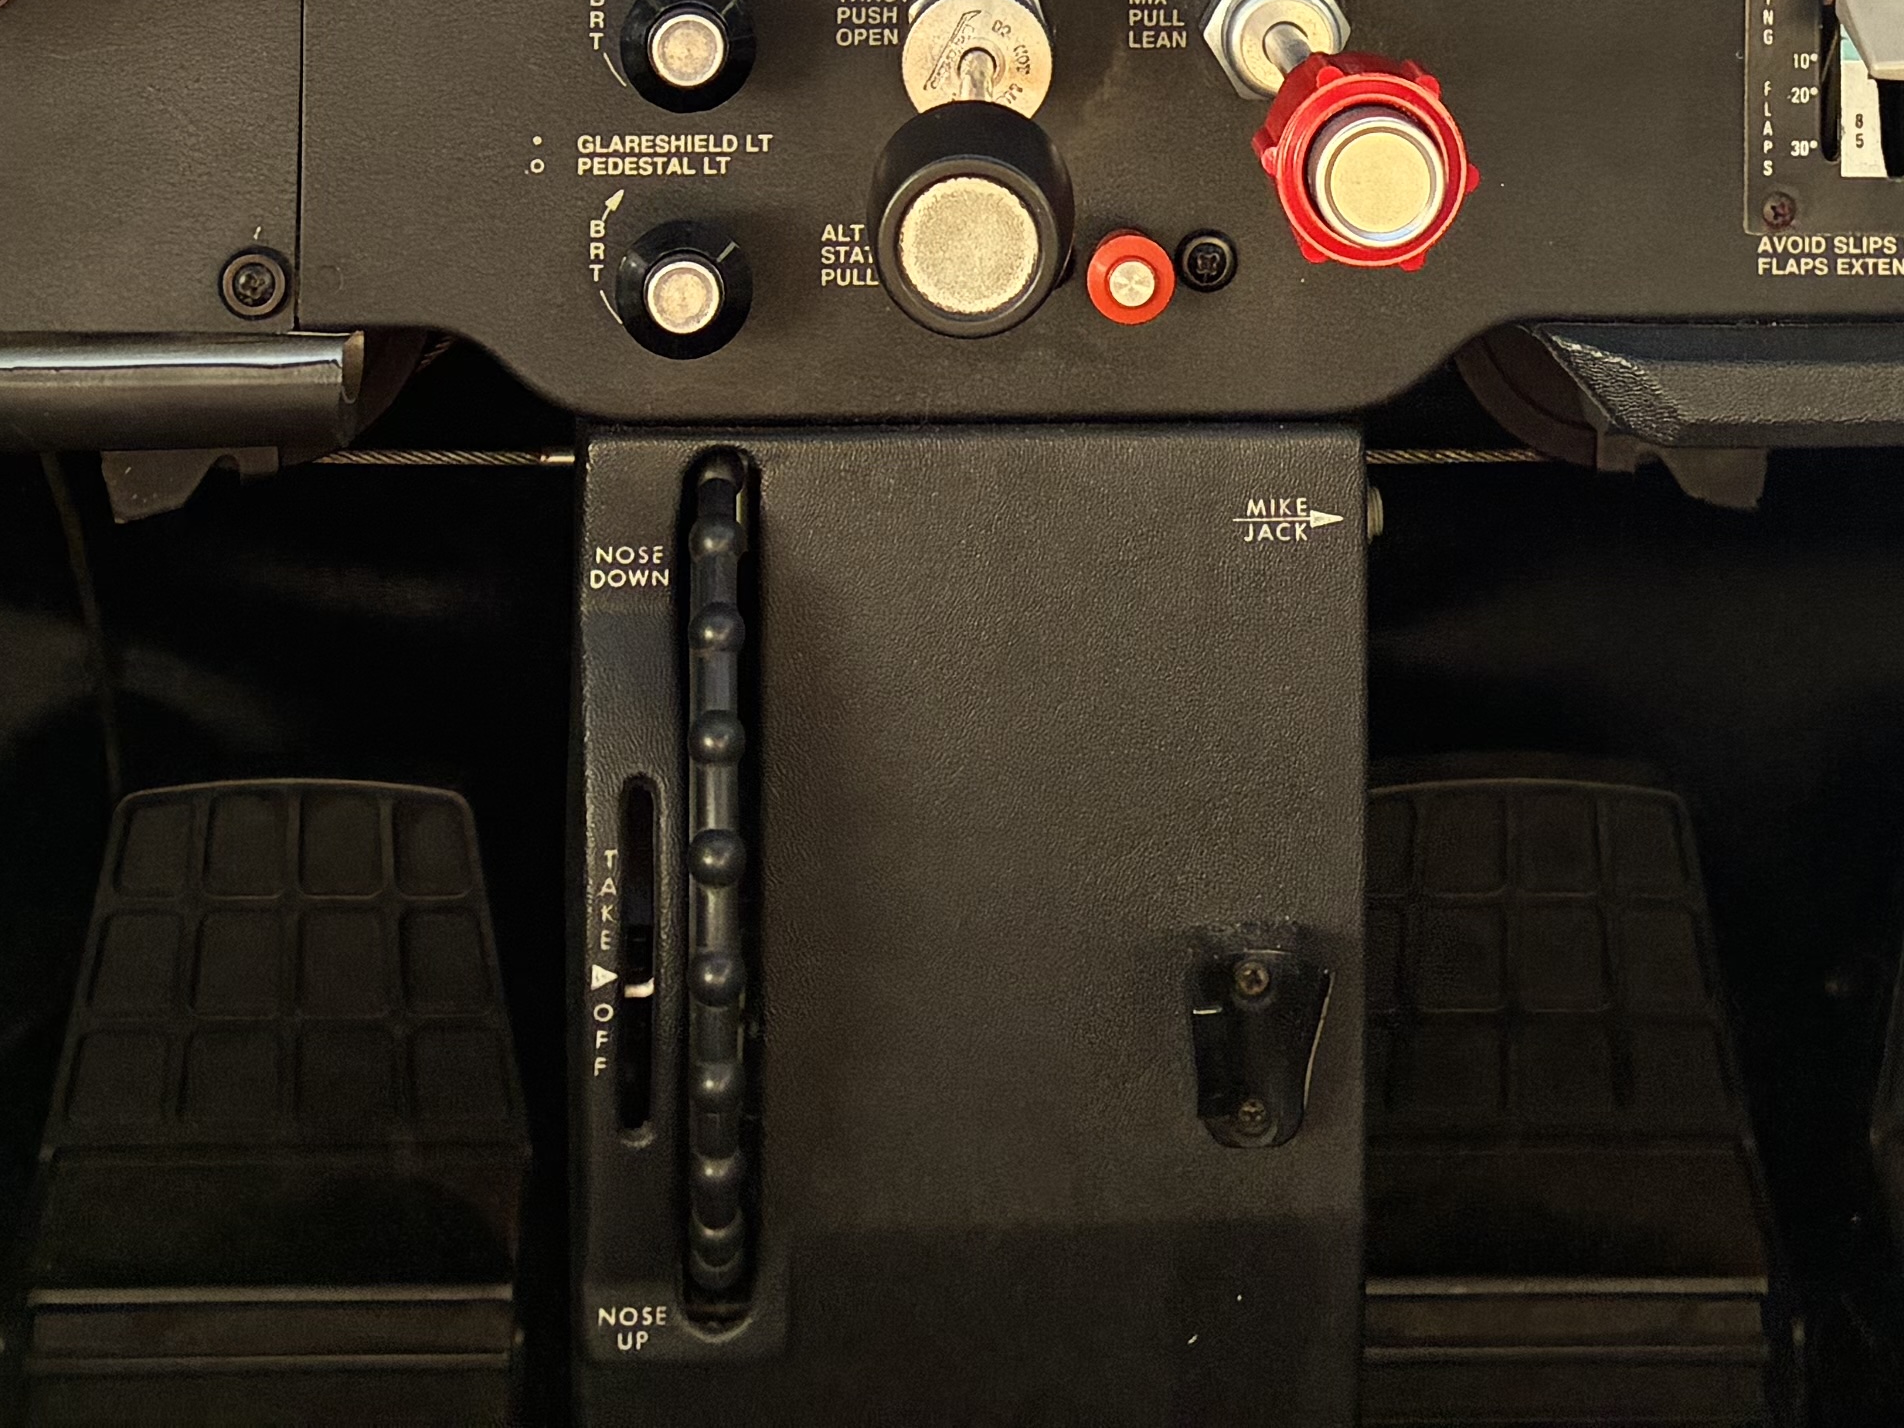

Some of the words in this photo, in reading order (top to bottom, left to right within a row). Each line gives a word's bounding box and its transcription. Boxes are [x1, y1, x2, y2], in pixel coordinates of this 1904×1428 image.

[1128, 8, 1186, 27] PULL
[1128, 30, 1187, 49] LEAN
[576, 133, 739, 154] GLARESHIELD
[745, 133, 774, 153] LT
[577, 156, 697, 176] PEDESTAL
[703, 156, 732, 175] LT
[1757, 235, 1827, 255] AVOID
[1833, 235, 1898, 255] SLIPS
[1757, 256, 1829, 276] FLAPS
[1243, 522, 1308, 543] JACK
[595, 545, 664, 565] NOSE
[589, 568, 670, 590] DOWN
[597, 1305, 667, 1327] NOSE
